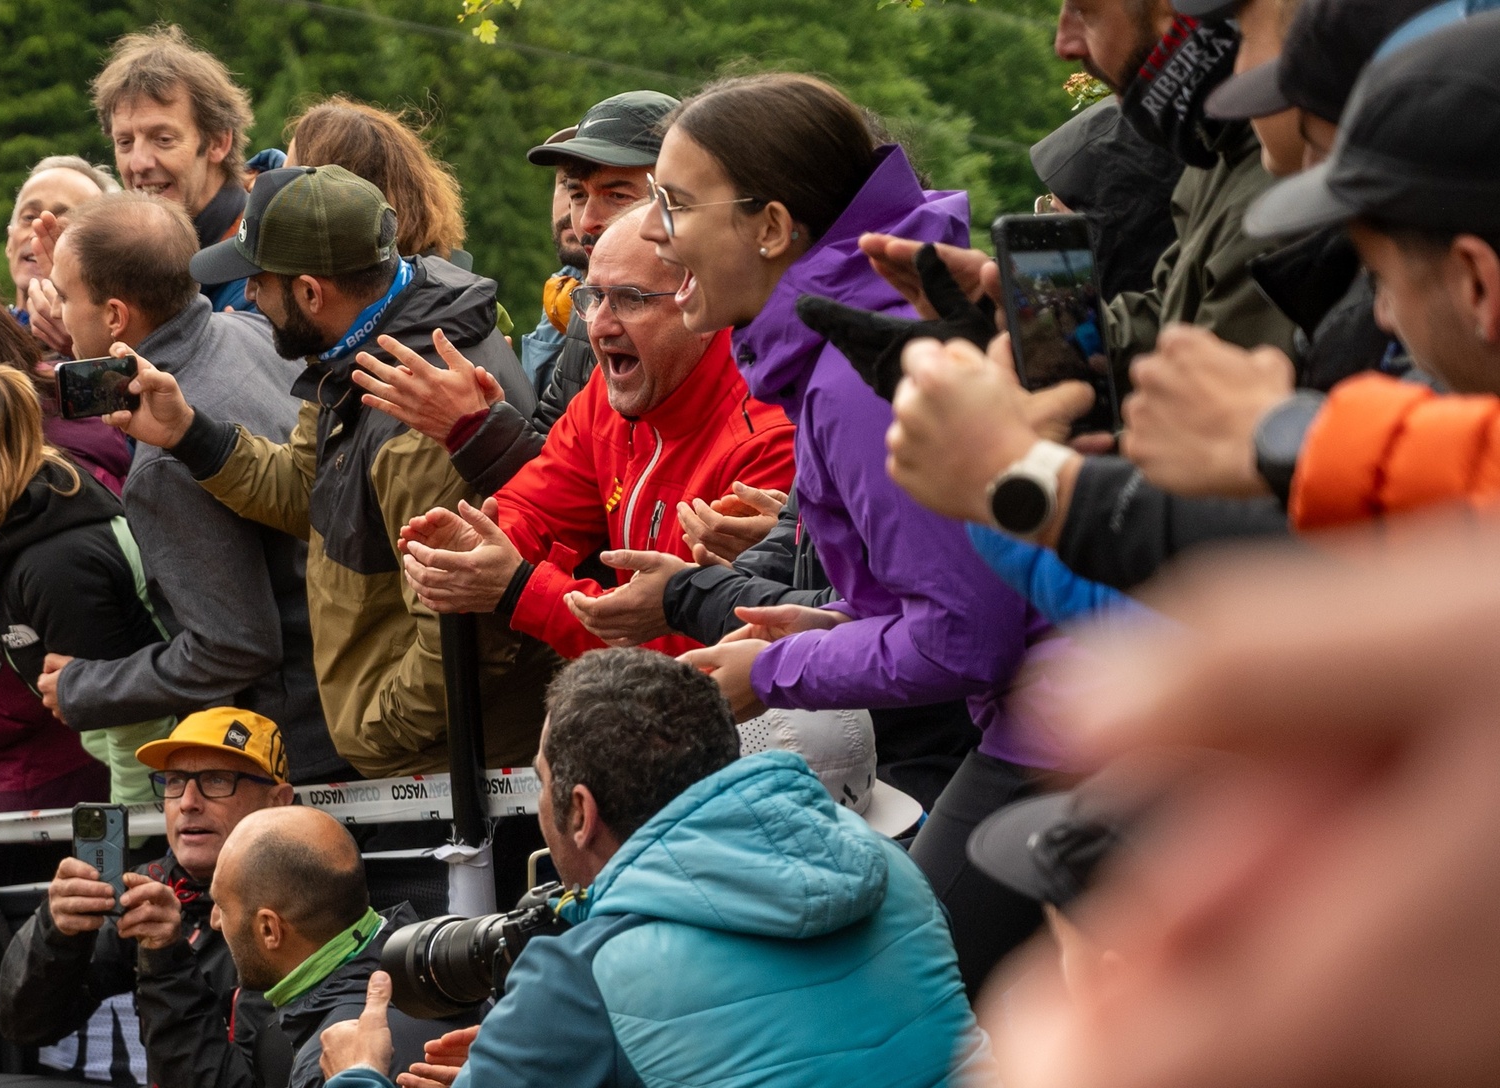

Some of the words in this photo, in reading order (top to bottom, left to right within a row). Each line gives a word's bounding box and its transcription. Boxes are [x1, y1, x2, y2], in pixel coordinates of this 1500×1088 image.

[1140, 27, 1216, 118] RIBEIRA
[309, 788, 346, 805] VASCO
[391, 782, 428, 800] VASCO
